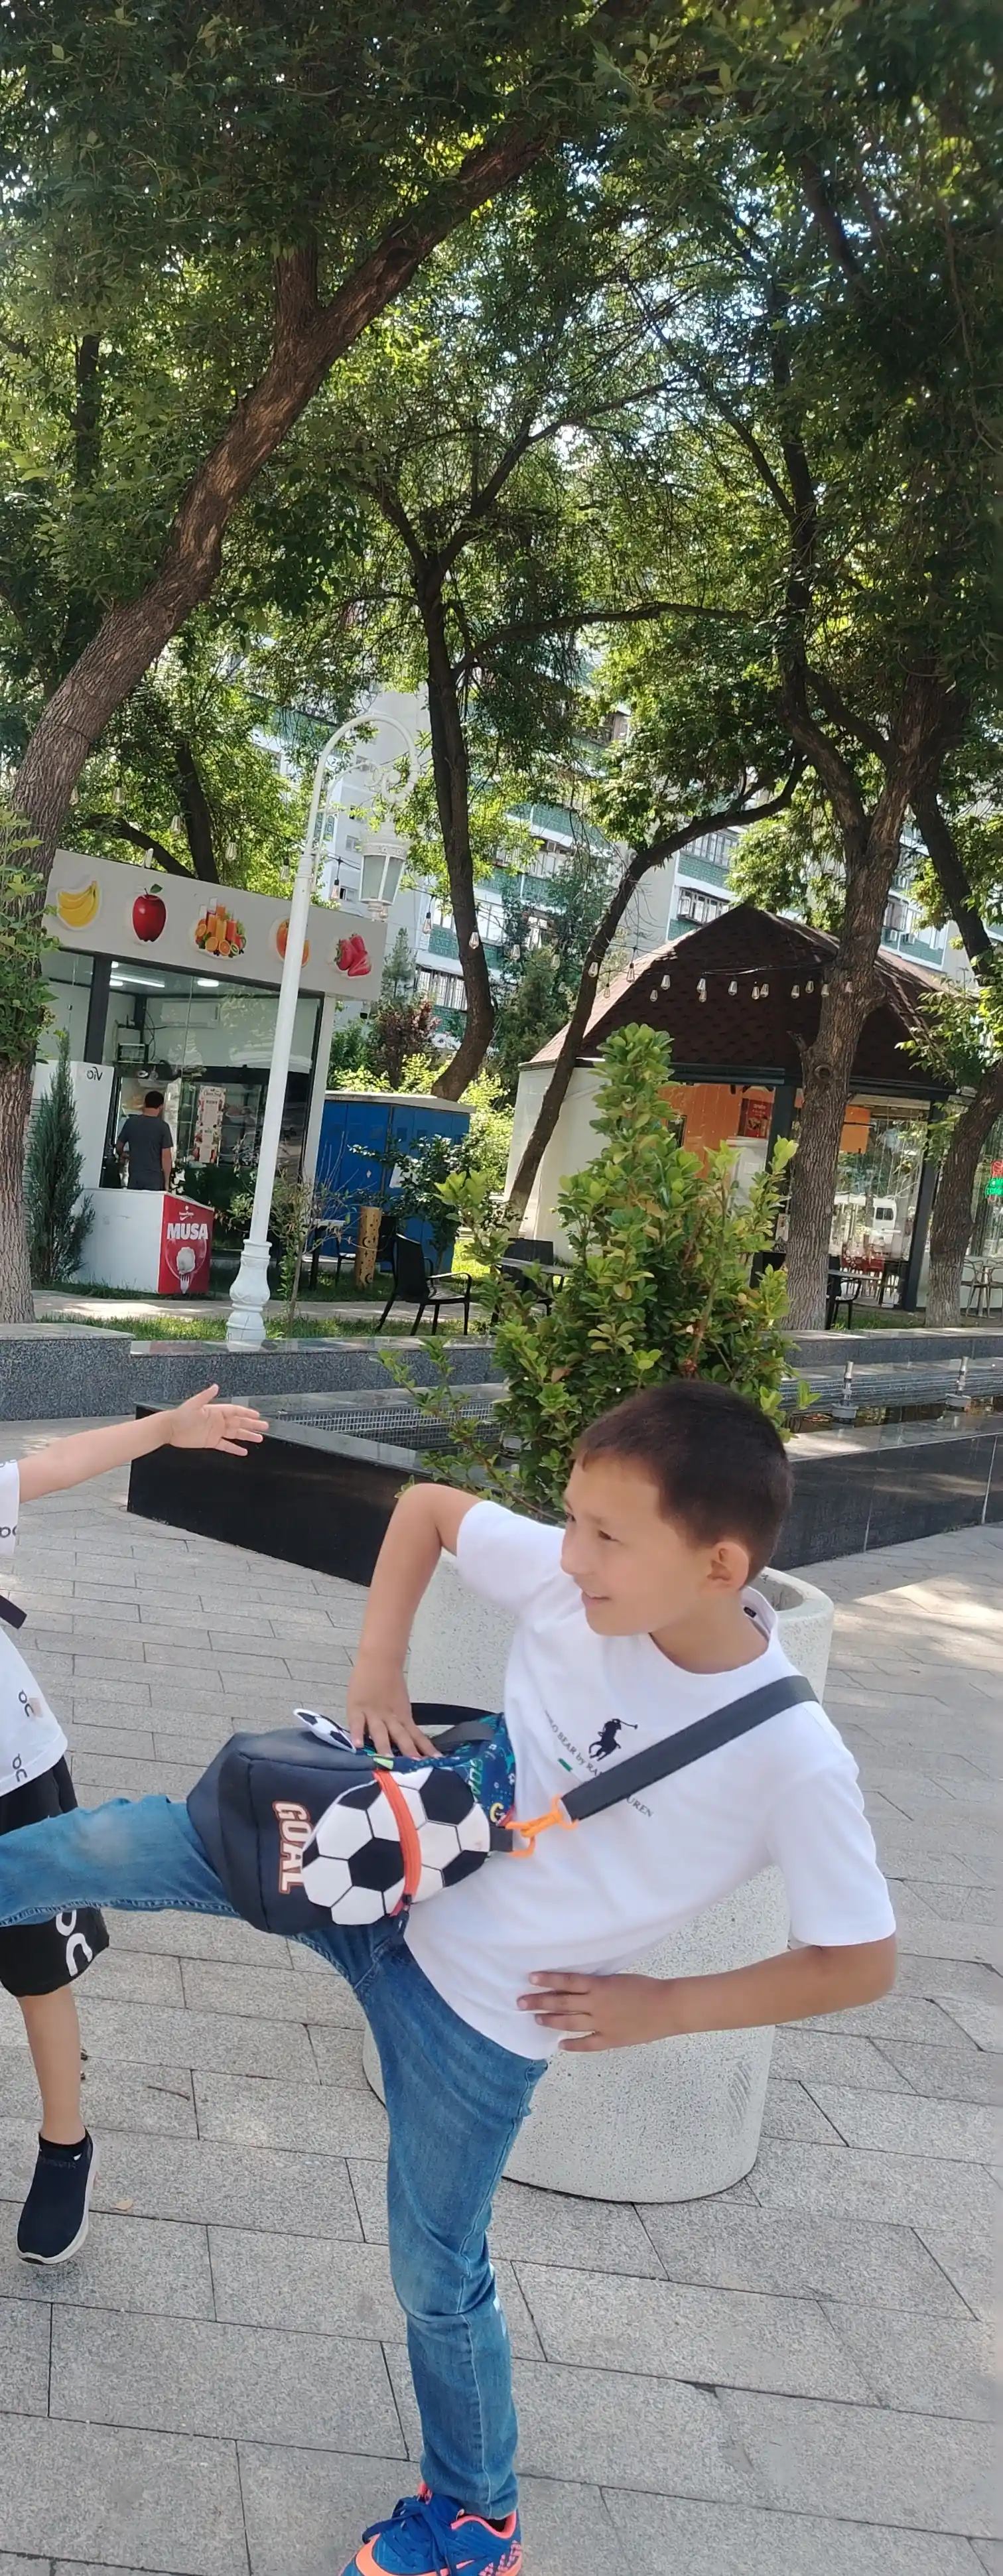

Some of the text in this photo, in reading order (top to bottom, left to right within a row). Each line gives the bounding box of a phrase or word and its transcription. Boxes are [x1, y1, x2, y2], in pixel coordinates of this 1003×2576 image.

[167, 1223, 208, 1240] MUSA
[557, 1731, 577, 1755] BEAR
[575, 1752, 586, 1765] by
[626, 1796, 654, 1818] UREN
[272, 1800, 313, 1894] GOAL
